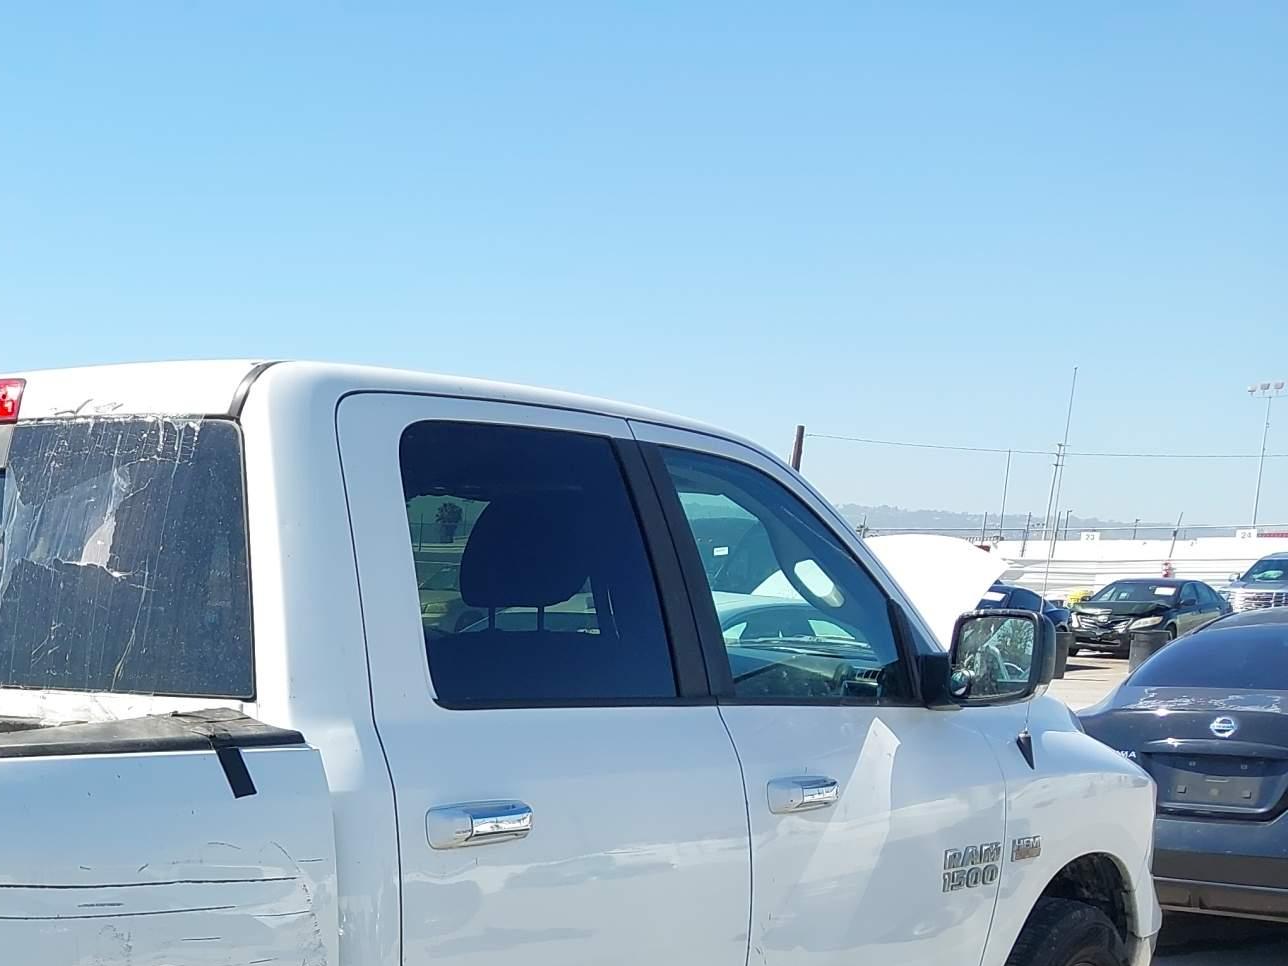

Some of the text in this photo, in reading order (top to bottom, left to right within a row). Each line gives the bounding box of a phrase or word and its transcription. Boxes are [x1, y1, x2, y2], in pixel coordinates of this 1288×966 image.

[1240, 531, 1252, 540] 24
[943, 842, 1002, 870] RAM
[942, 864, 999, 893] 1500
